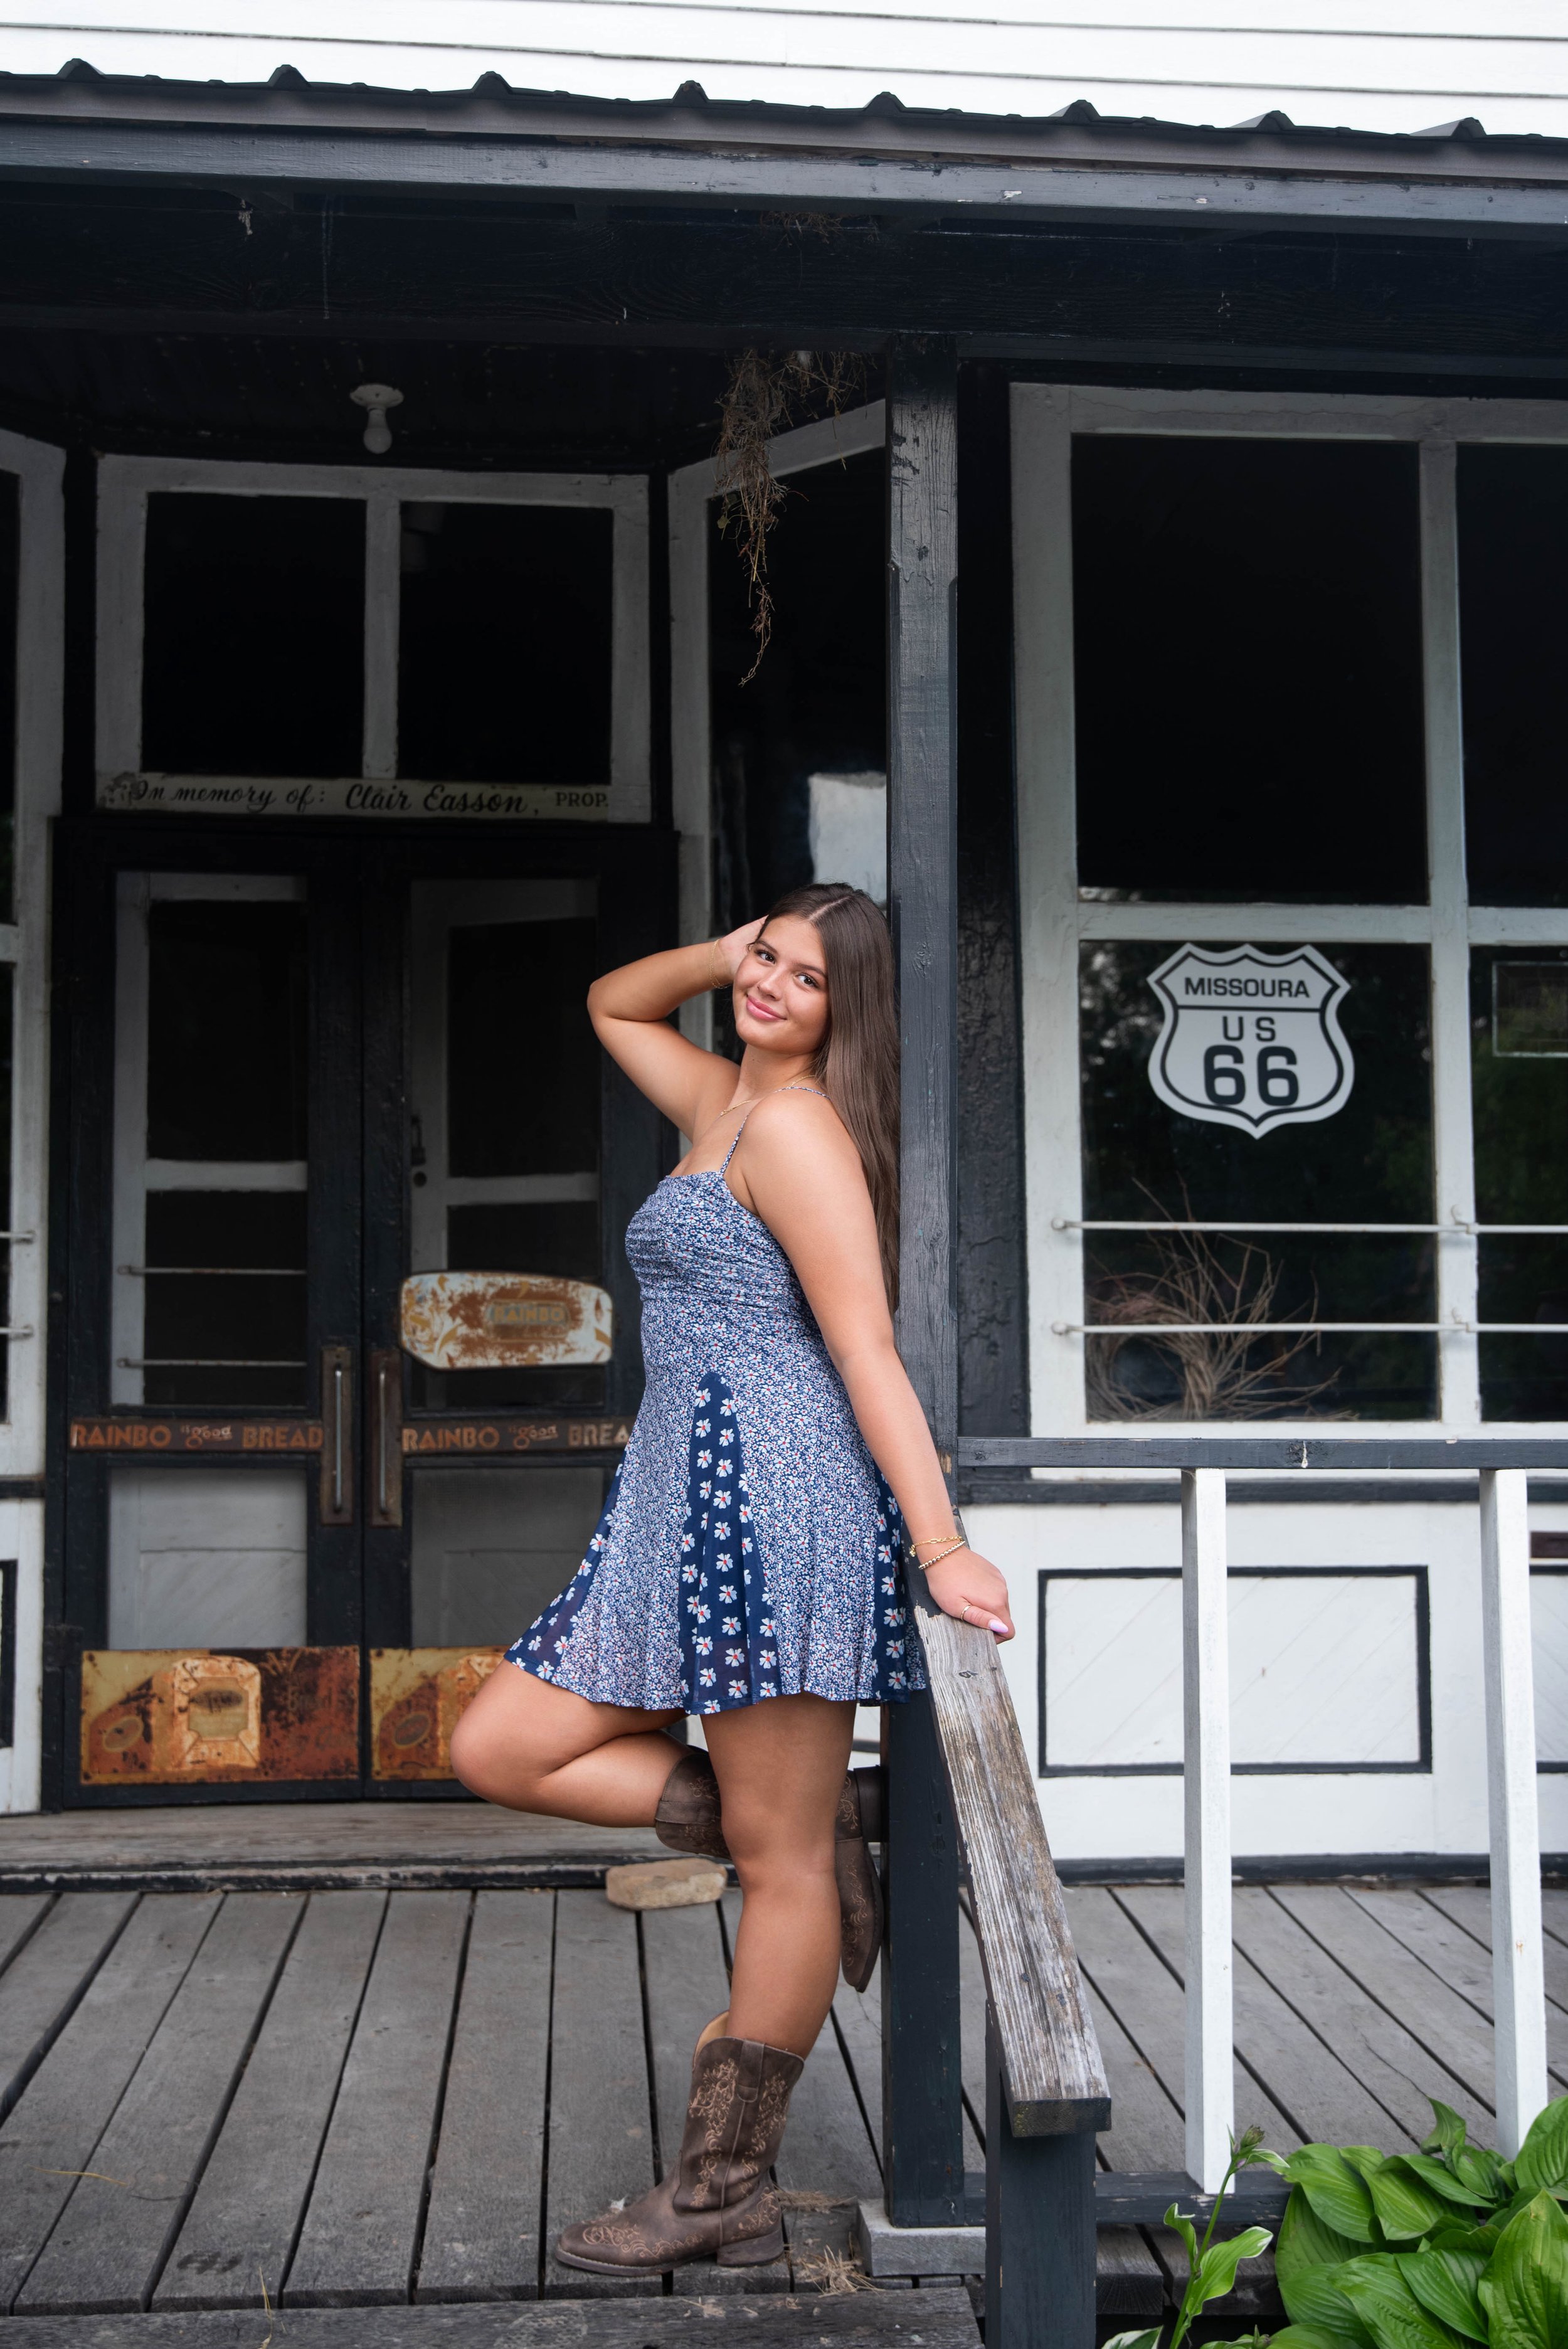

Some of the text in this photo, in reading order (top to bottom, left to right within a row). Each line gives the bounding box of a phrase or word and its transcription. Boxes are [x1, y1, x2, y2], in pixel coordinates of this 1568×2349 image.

[171, 785, 276, 813] memory
[346, 783, 411, 810] Clair
[555, 791, 609, 808] PROP.
[1184, 977, 1310, 999] MISSOURA
[1203, 1044, 1299, 1107] 66
[494, 1305, 564, 1322] RAINBO
[70, 1424, 172, 1448] RAINBO
[184, 1424, 232, 1450] good
[242, 1425, 324, 1448] BREAD
[401, 1426, 501, 1451] RAINBO
[513, 1424, 558, 1450] good
[568, 1423, 630, 1446] BREA
